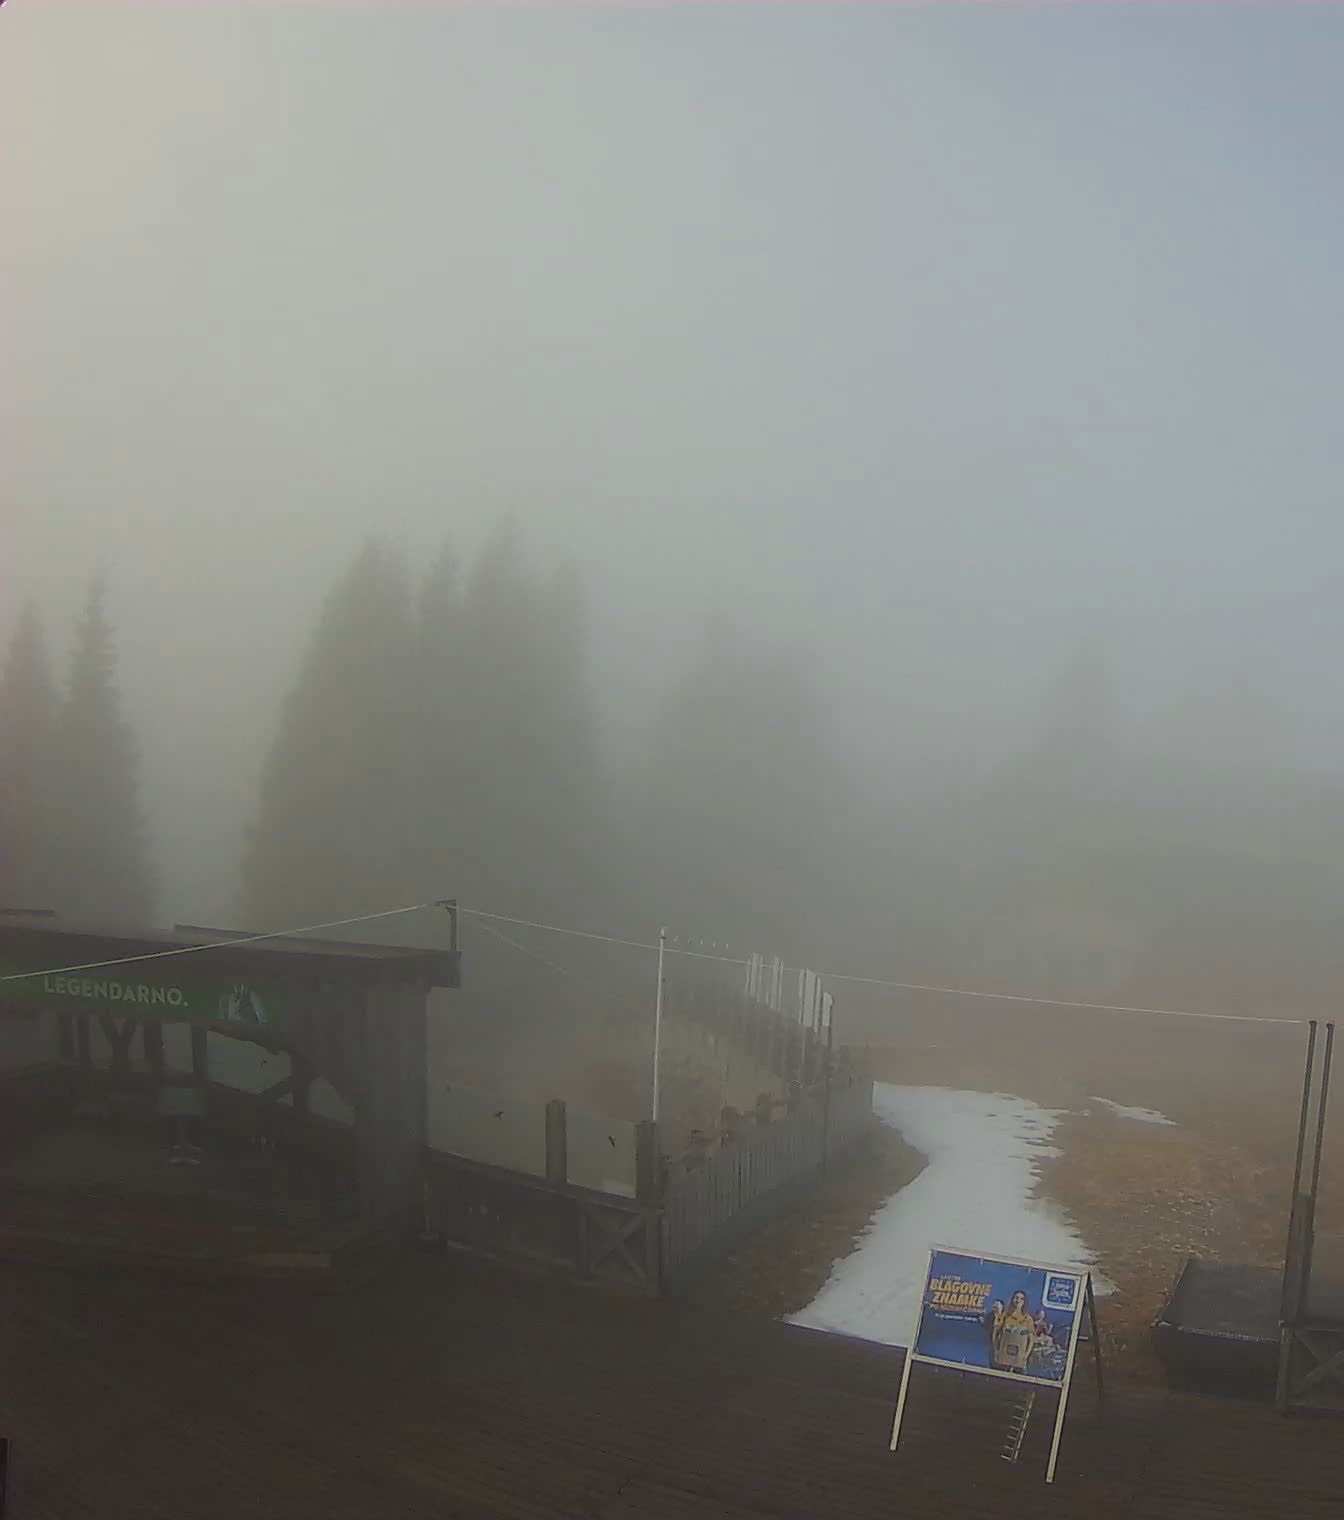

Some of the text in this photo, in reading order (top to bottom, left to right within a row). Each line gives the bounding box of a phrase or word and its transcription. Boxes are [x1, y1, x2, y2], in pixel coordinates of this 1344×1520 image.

[44, 974, 189, 1008] LEGENDARNO.
[930, 1278, 992, 1296] BLAGOVNE
[932, 1291, 985, 1307] ZNAMKE
